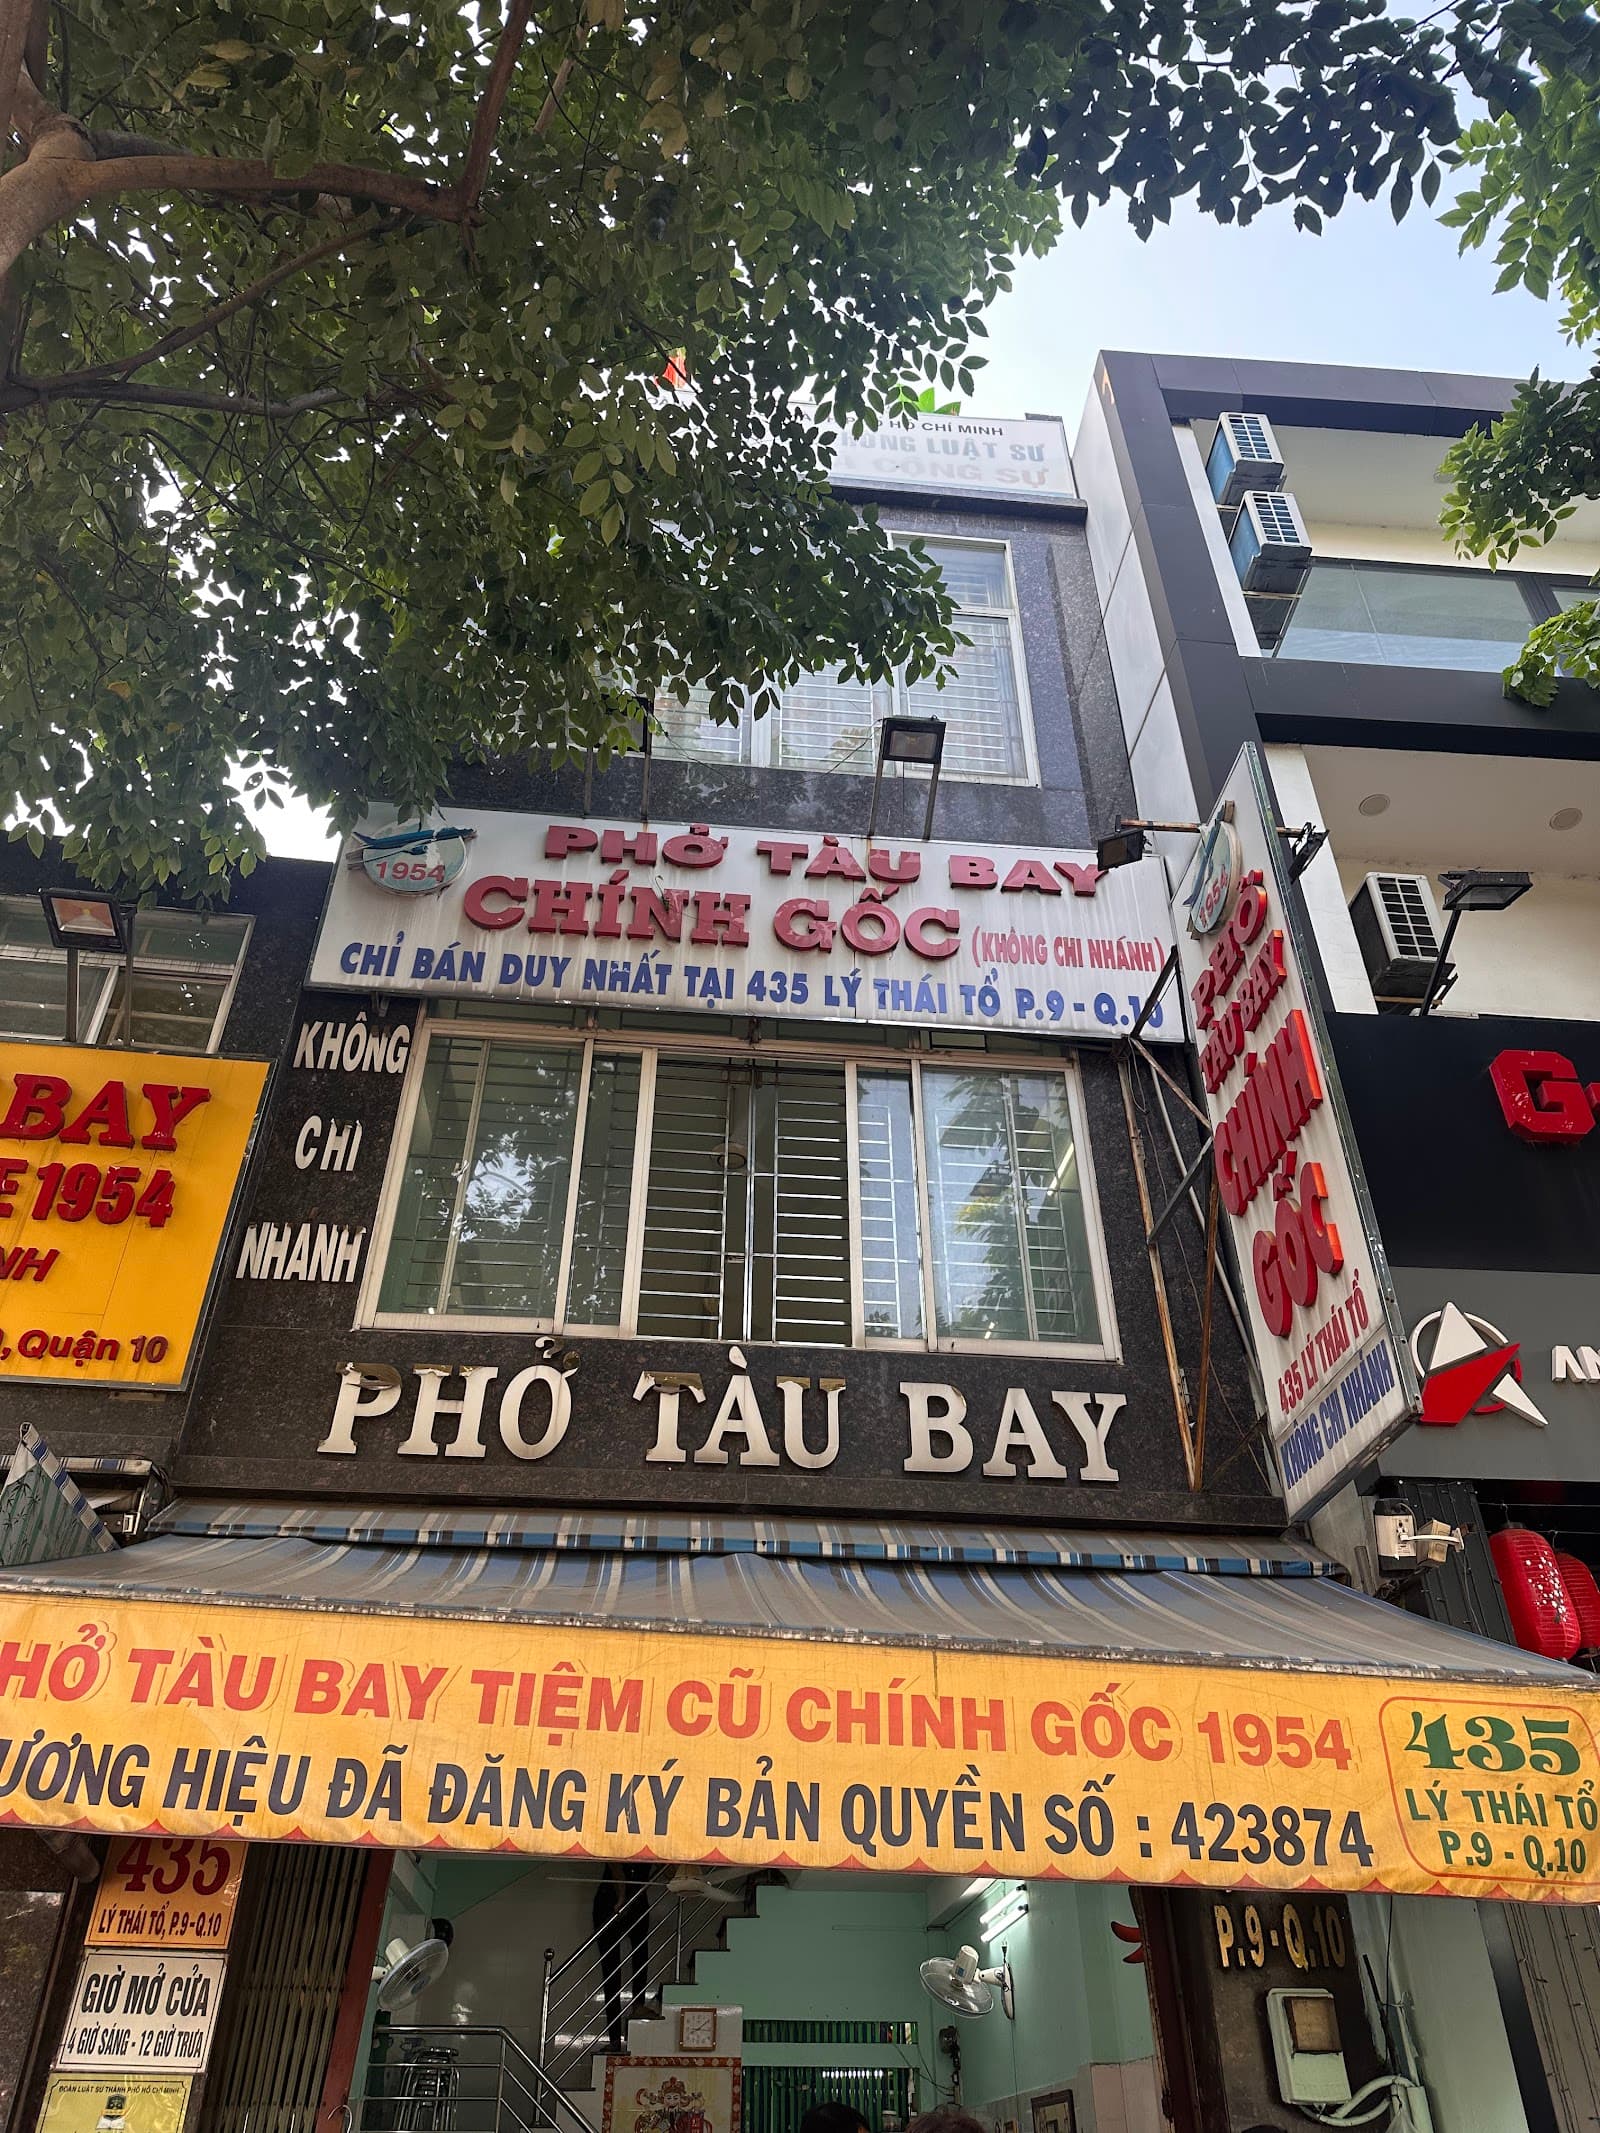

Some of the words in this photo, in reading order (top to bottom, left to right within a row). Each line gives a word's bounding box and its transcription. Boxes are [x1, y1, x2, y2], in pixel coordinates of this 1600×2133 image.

[921, 421, 952, 433] CHÍ
[958, 424, 1004, 436] MINH
[926, 437, 998, 460] LUẬT
[1008, 442, 1046, 462] SƯ
[995, 467, 1049, 488] SỰ
[375, 860, 446, 884] 1954
[545, 824, 729, 868] PHỞ
[756, 835, 921, 883] TÀU
[948, 854, 1109, 897] BAY
[464, 869, 752, 948] CHÍNH
[773, 885, 961, 960] GỐC
[1199, 863, 1229, 929] 1954
[340, 930, 406, 977] CHỈ
[411, 939, 487, 984] BÁN
[499, 954, 573, 989] DUY
[582, 950, 673, 996] NHẤT
[684, 965, 735, 1009] TẠI
[747, 969, 809, 1005] 435
[824, 967, 862, 1009] LÝ
[873, 973, 947, 1015] THÁI
[960, 966, 1001, 1018] TỔ
[1015, 987, 1065, 1021] P.9
[972, 925, 1047, 967] (KHÔNG
[1053, 936, 1082, 968] CHI
[1087, 933, 1165, 973] NHÁNH)
[1190, 869, 1268, 1030] PHỞ
[1236, 929, 1287, 1032] BAY
[293, 1011, 411, 1074] KHÔNG
[0, 1073, 212, 1152] BAY
[294, 1114, 363, 1172] CHI
[1213, 1009, 1323, 1217] CHÍNH
[31, 1162, 176, 1228] 1954
[1252, 1150, 1344, 1339] GỐC
[17, 1328, 121, 1367] Quận
[130, 1334, 169, 1364] 10
[1278, 1359, 1304, 1417] 435
[1300, 1338, 1316, 1389] LÝ
[1315, 1303, 1350, 1375] THÁI
[1345, 1268, 1369, 1341] TỔ
[315, 1336, 580, 1461] PHỞ
[631, 1345, 848, 1470] TÀU
[898, 1380, 1129, 1483] BAY
[1279, 1422, 1325, 1490] KHÔNG
[1319, 1400, 1347, 1450] CHI
[1340, 1339, 1395, 1427] NHÁNH
[0, 1623, 107, 1701] HỞ
[127, 1636, 277, 1712] TÀU
[293, 1658, 450, 1721] BAY
[471, 1660, 645, 1747] TIỆM
[666, 1667, 762, 1740] CŨ
[785, 1677, 1005, 1753] CHÍNH
[1031, 1682, 1174, 1762] GỐC
[1197, 1710, 1353, 1771] 1954
[1404, 1711, 1581, 1776] 435
[0, 1729, 150, 1808] ƯƠNG
[162, 1735, 312, 1827] HIỆU
[325, 1744, 408, 1822] ĐÃ
[426, 1753, 587, 1832] ĐĂNG
[605, 1758, 685, 1836] KÝ
[705, 1755, 820, 1842] BẢN
[840, 1763, 1027, 1858] QUYỀN
[1044, 1773, 1116, 1857] SỐ
[1171, 1801, 1374, 1867] 423874
[1405, 1779, 1448, 1822] LÝ
[1461, 1783, 1548, 1827] THÁI
[1554, 1778, 1599, 1831] TỔ
[116, 1838, 231, 1896] 435
[1438, 1829, 1493, 1867] P.9
[1523, 1834, 1587, 1877] Q.10
[98, 1903, 117, 1934] LÝ
[116, 1903, 147, 1935] THÁI
[81, 1964, 126, 2014] GIỜ
[122, 1962, 167, 2015] MỞ
[165, 1963, 211, 2017] CỬA
[67, 2027, 77, 2054] 4
[76, 2021, 100, 2055] GIỜ
[98, 2022, 131, 2056] SÁNG
[138, 2029, 154, 2057] 12
[153, 2023, 176, 2057] GIỜ
[174, 2028, 204, 2058] TRƯA
